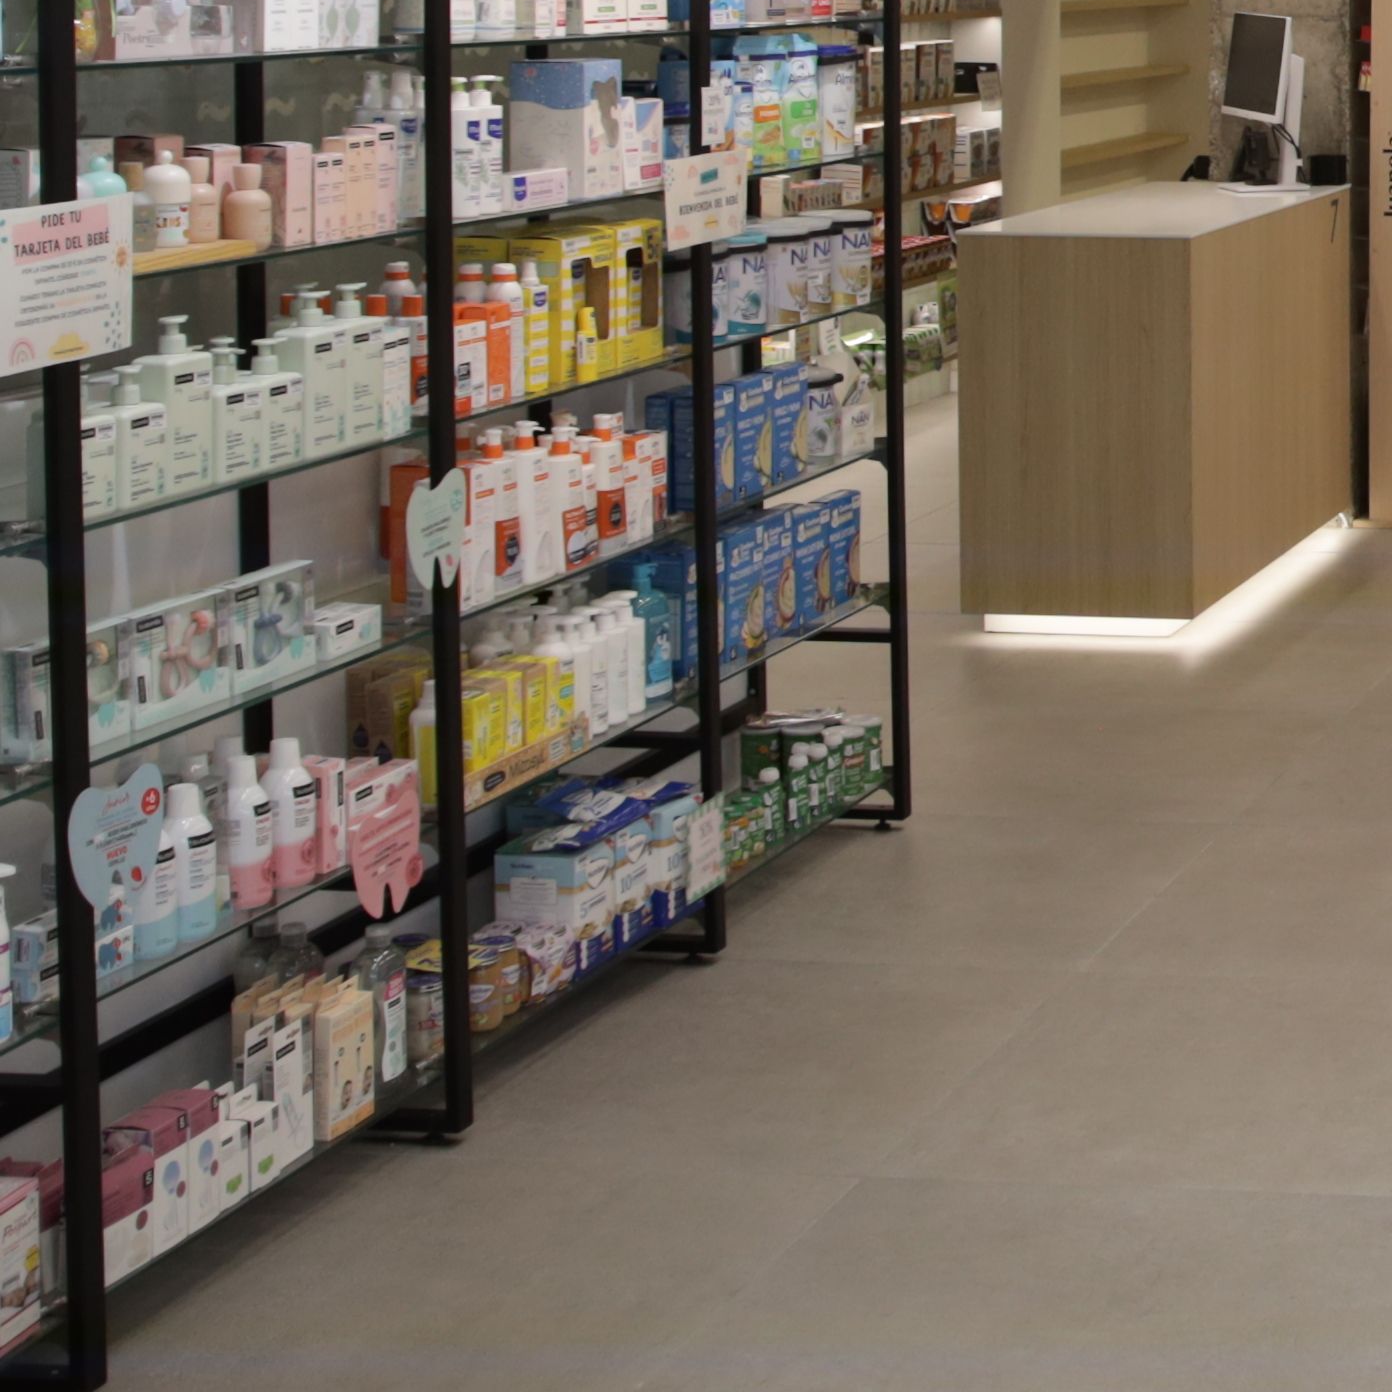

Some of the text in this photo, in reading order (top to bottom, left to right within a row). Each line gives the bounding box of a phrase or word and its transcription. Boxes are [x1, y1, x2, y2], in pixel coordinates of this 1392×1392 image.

[41, 210, 82, 228] PIDE TU
[14, 227, 110, 257] TARJETA DEL BEBÉ
[743, 257, 765, 274] NA
[809, 393, 833, 410] NA
